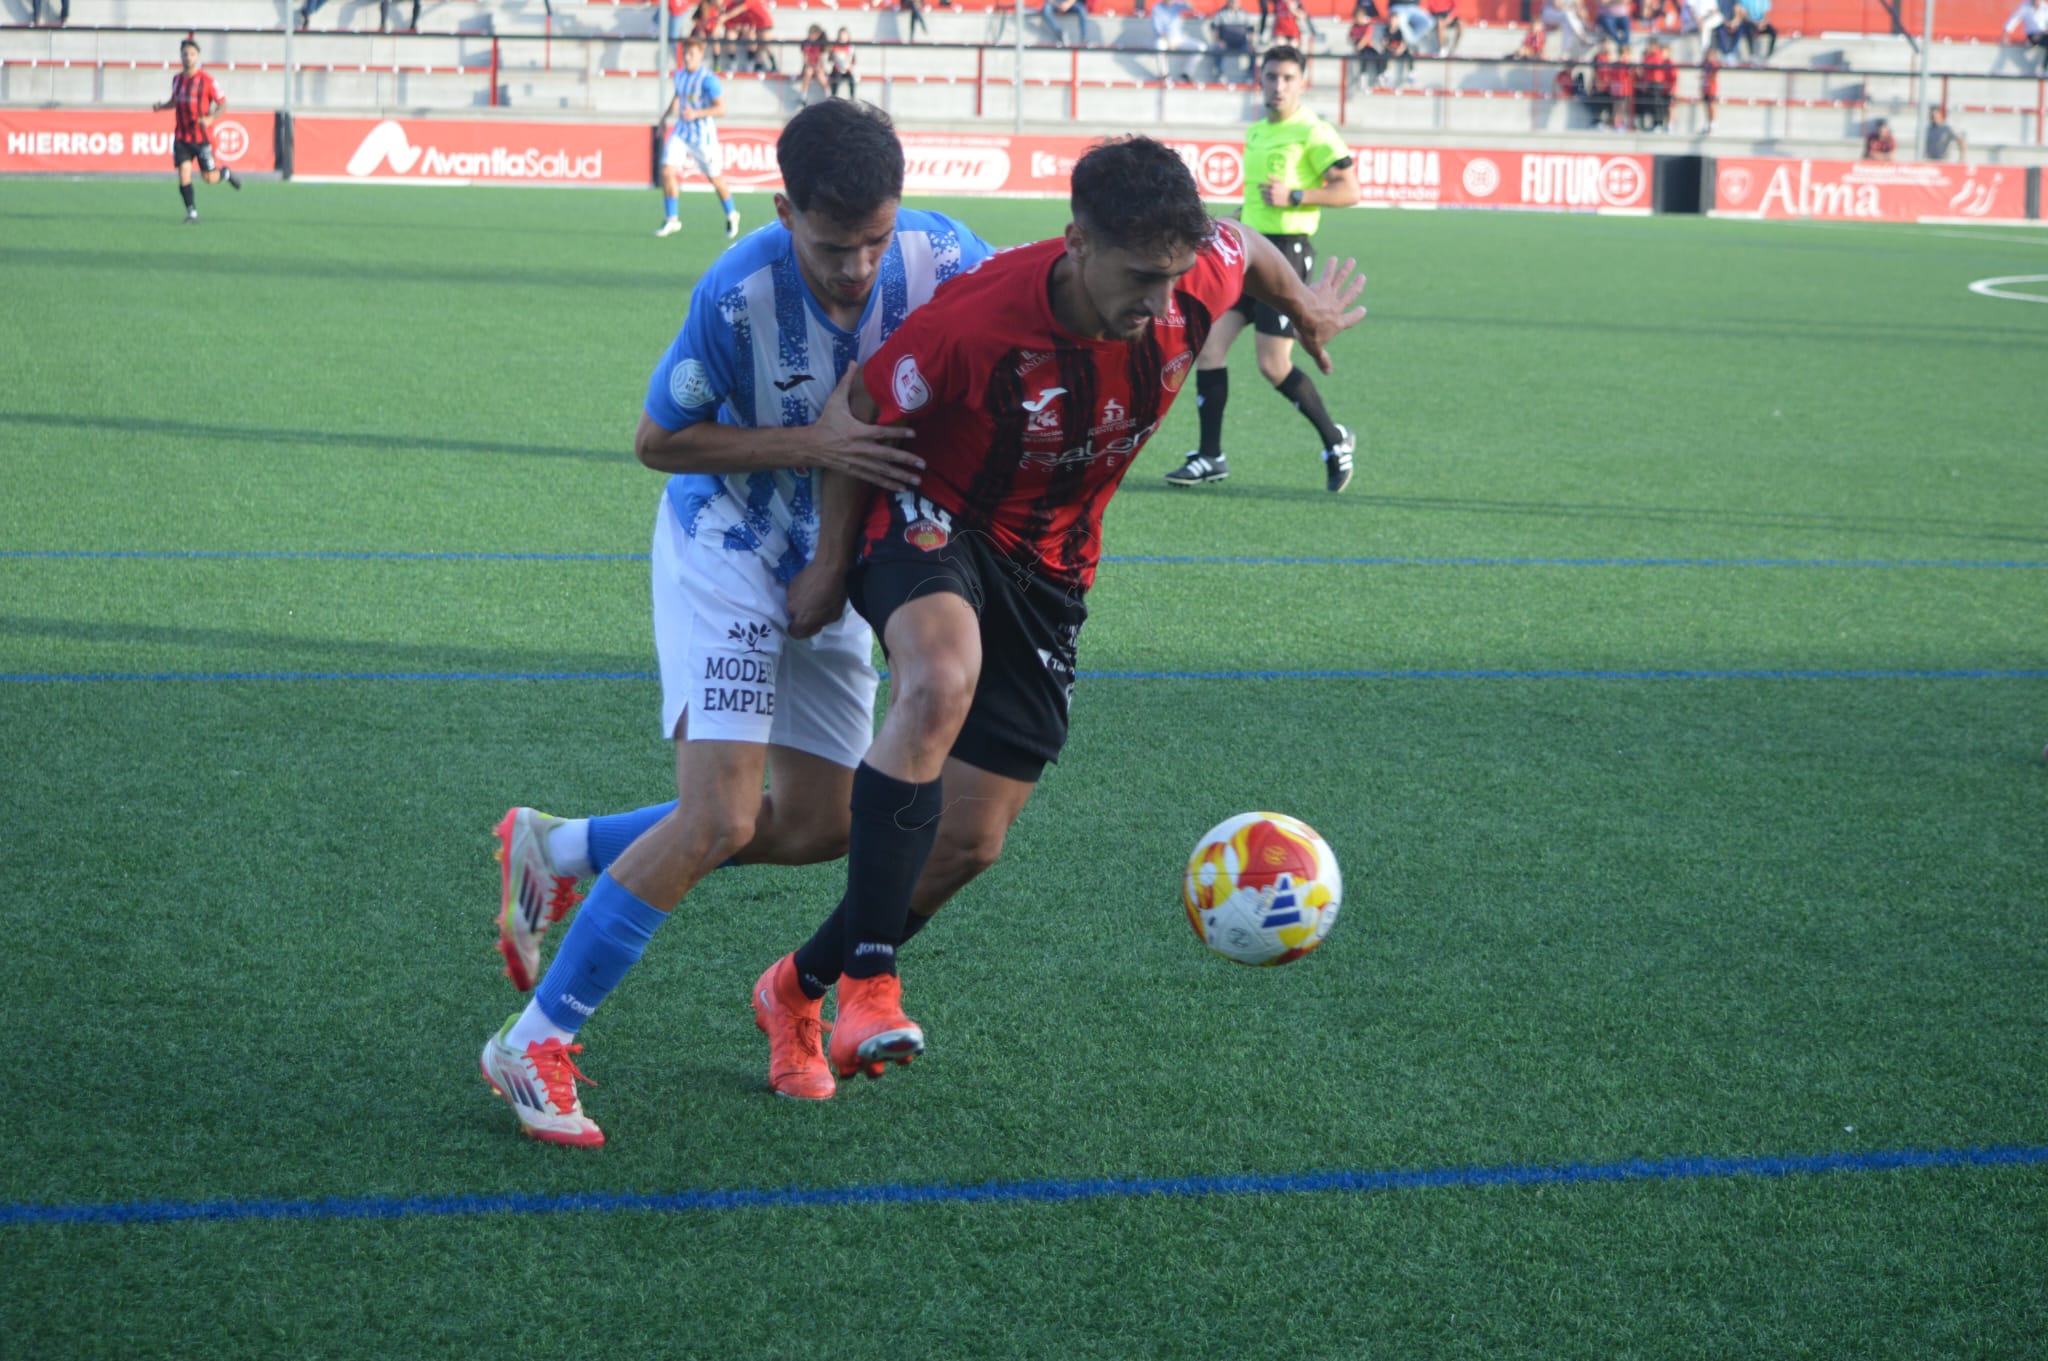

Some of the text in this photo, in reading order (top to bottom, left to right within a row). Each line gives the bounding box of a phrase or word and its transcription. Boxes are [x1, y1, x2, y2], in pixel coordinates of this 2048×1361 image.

[7, 132, 124, 155] HIERROS
[420, 147, 602, 178] AvantiaSalud
[1350, 149, 1440, 186] GUNDA
[1757, 159, 1882, 217] Alma
